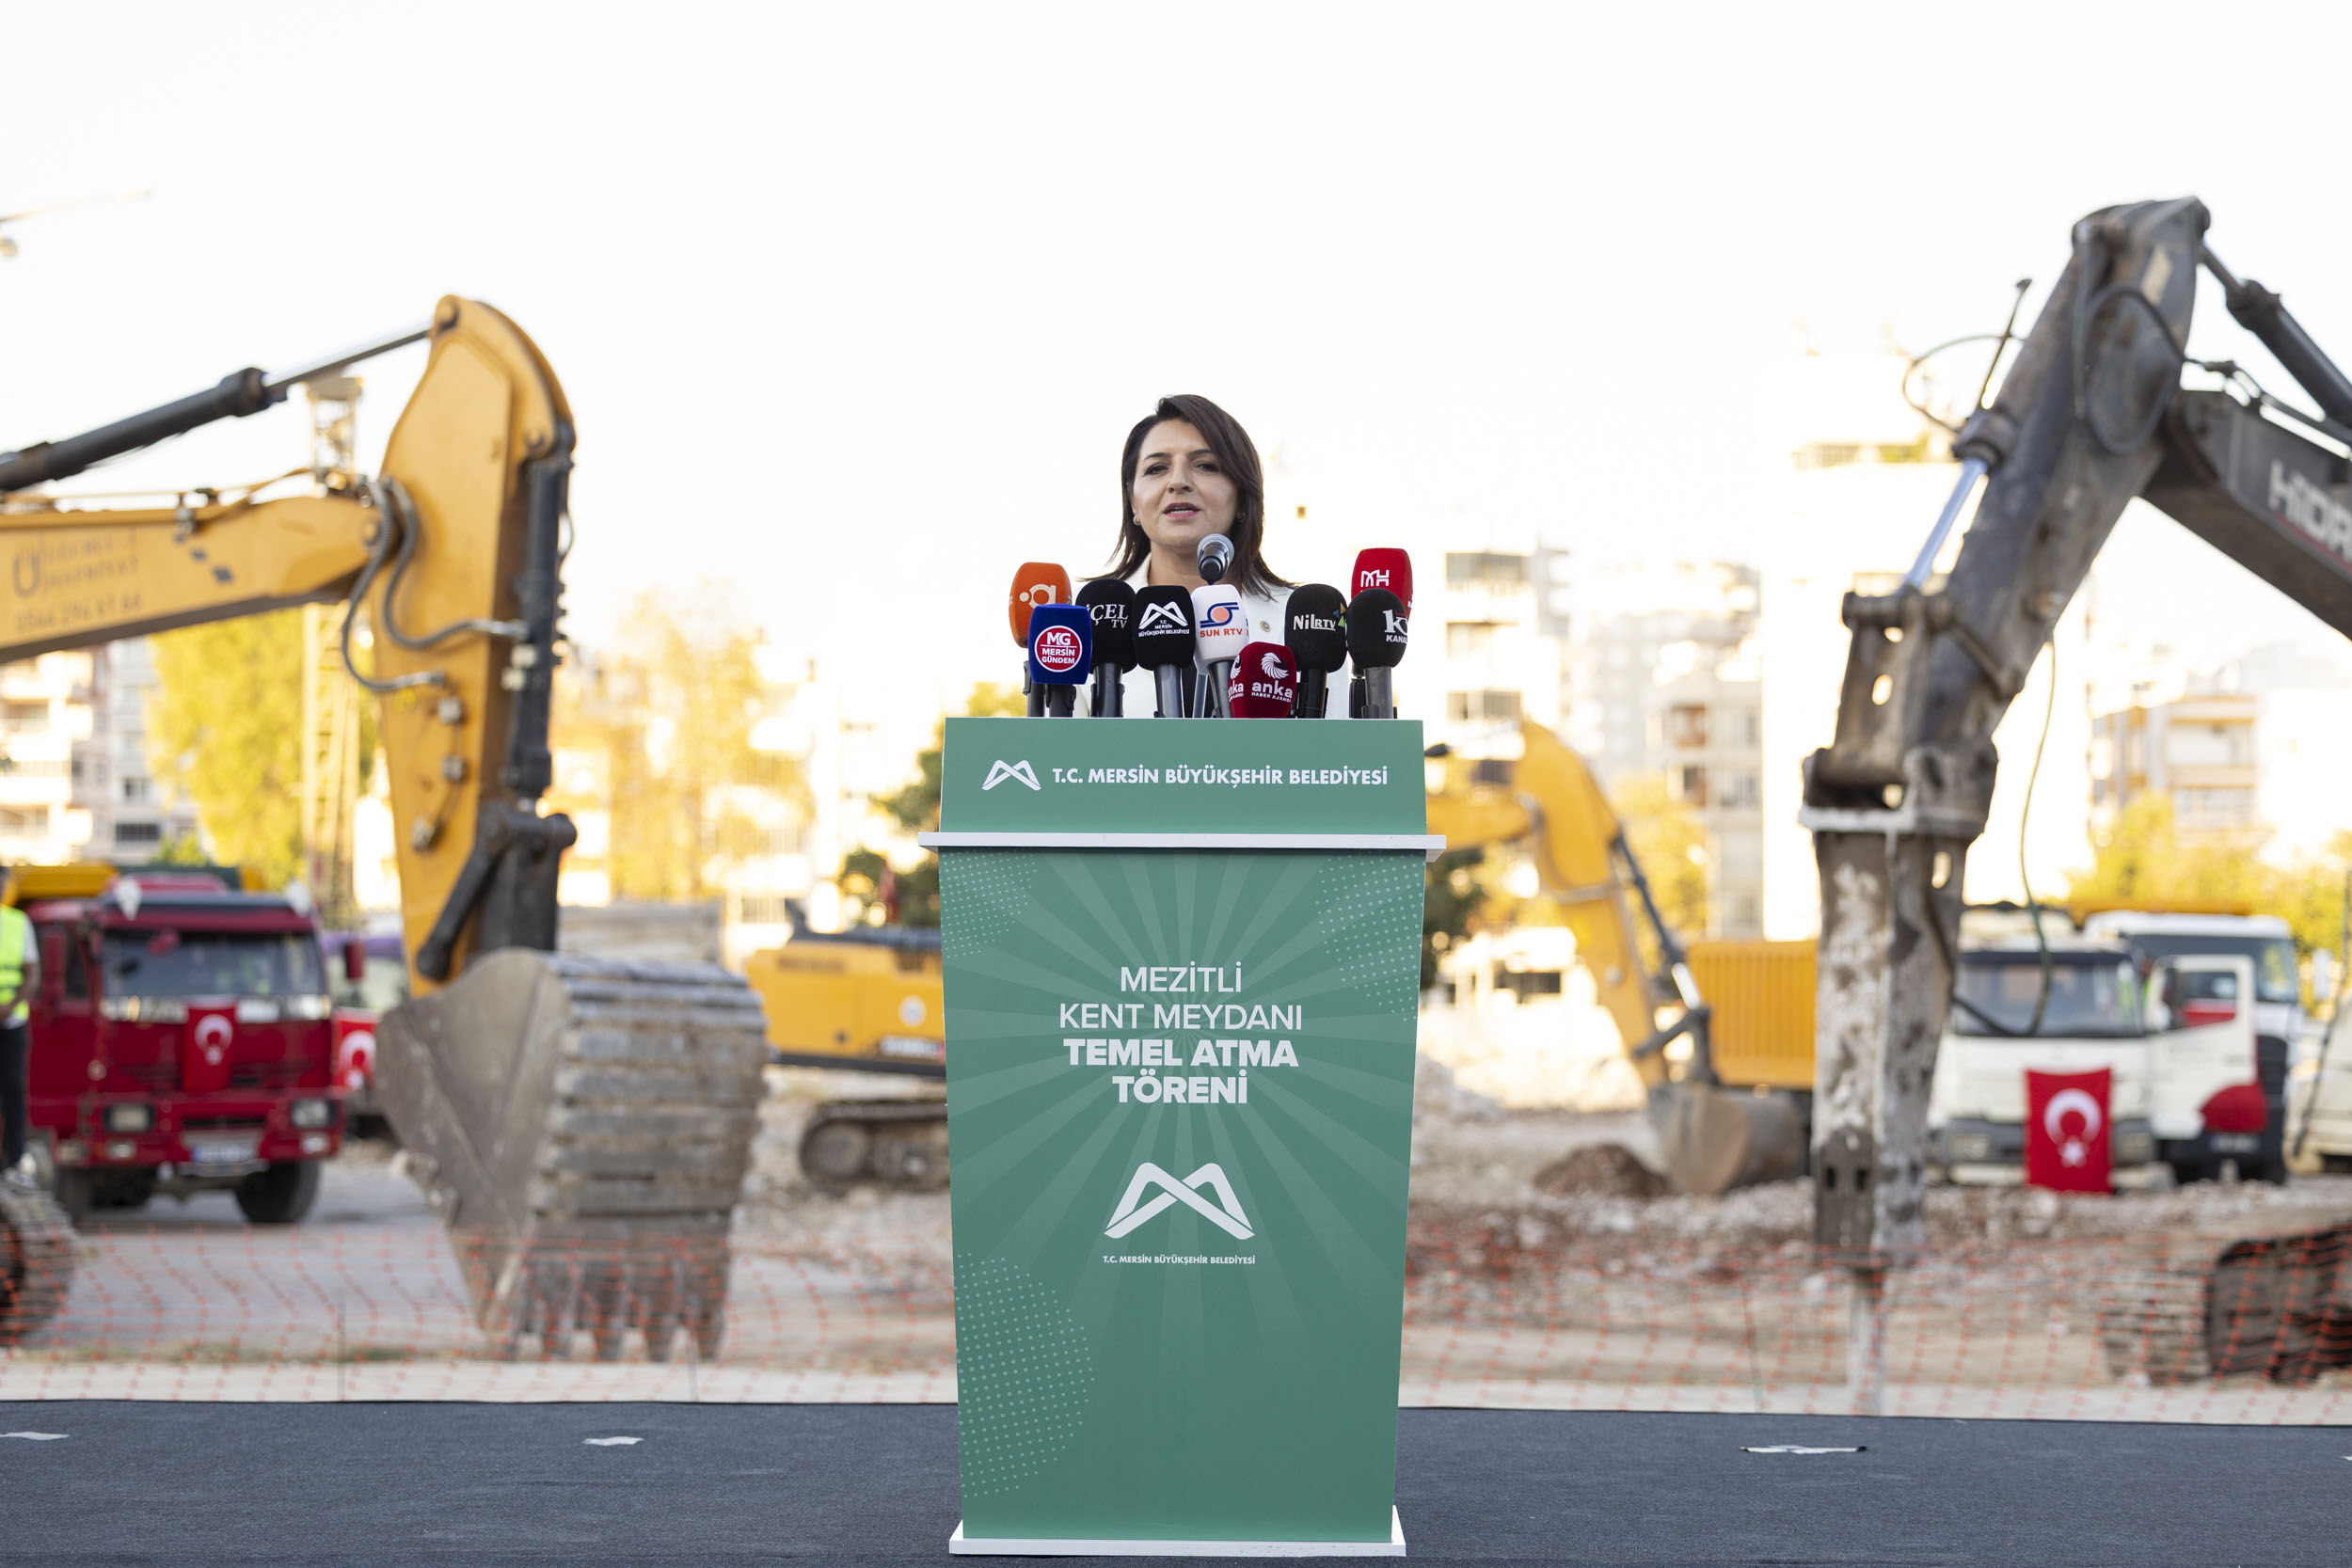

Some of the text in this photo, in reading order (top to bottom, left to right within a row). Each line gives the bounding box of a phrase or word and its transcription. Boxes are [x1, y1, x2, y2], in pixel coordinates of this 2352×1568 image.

[1111, 619, 1127, 628] TV
[1046, 631, 1072, 646] MG
[1138, 629, 1166, 638] BÜYÜKŞEHİR
[1200, 627, 1242, 638] SUN RTV
[1041, 646, 1075, 657] MERSİN
[1041, 656, 1075, 664] GÜNDEM
[1251, 680, 1294, 699] anka
[1272, 694, 1292, 704] AJANSI
[1052, 764, 1388, 788] T.C. MERSİN BÜYÜKŞEHİR BELEDİYESİ
[1120, 960, 1242, 992] MEZİTLİ
[1059, 1003, 1302, 1030] KENT MEYDANI
[1063, 1038, 1299, 1068] TEMEL ATMA
[1112, 1068, 1248, 1104] TÖRENİ
[1119, 1254, 1152, 1264] MERSİN
[1153, 1254, 1208, 1266] BÜYÜKŞEHİR
[1210, 1255, 1256, 1264] BELEDİYESİ
